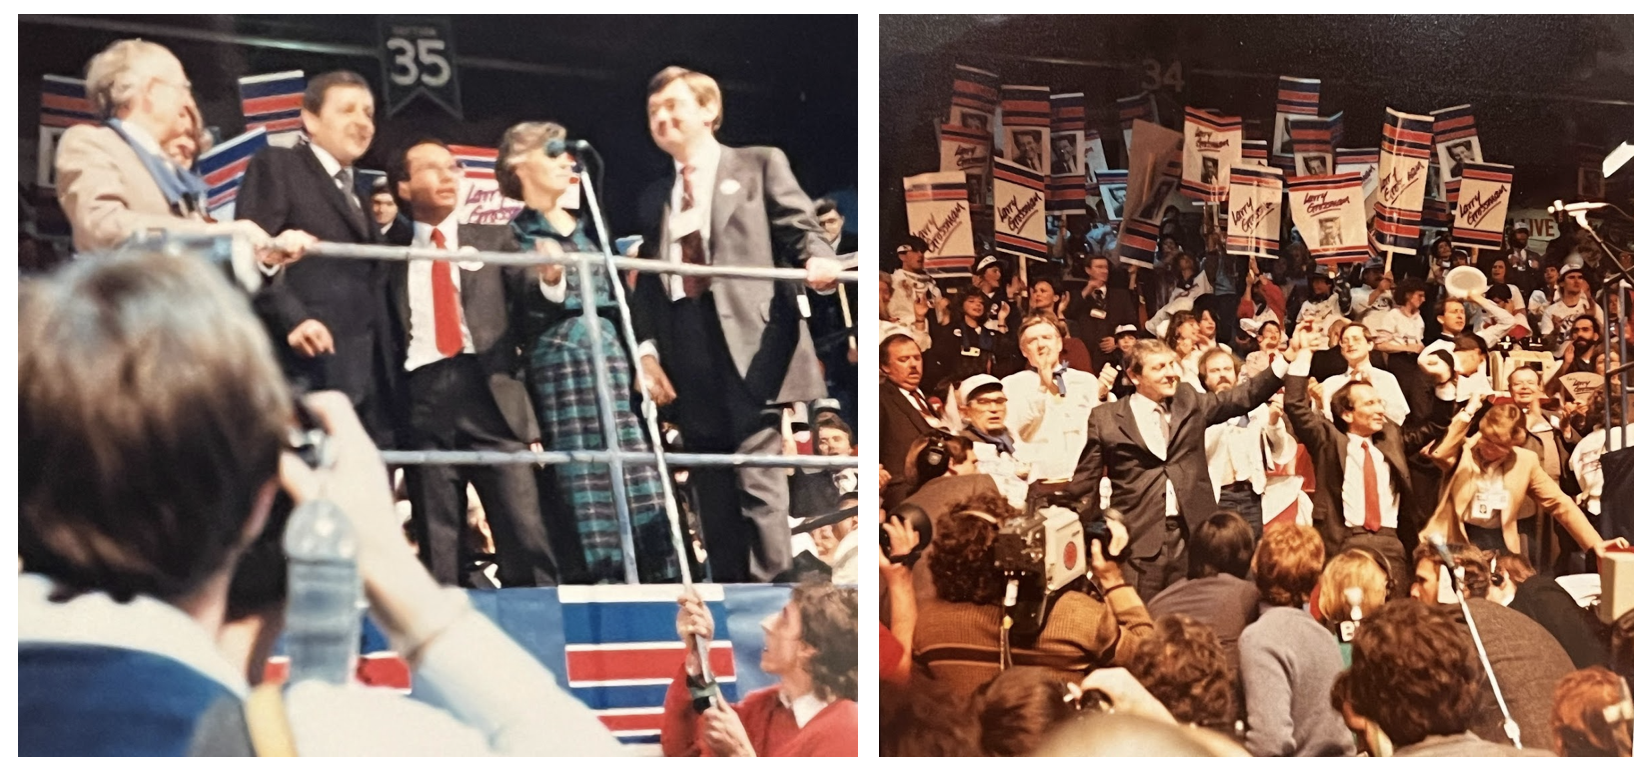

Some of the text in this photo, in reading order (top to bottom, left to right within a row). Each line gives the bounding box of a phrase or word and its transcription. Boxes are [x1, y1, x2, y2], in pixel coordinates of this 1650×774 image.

[387, 38, 451, 86] 35
[1141, 58, 1185, 92] 34
[997, 195, 1020, 223] Larry
[1008, 192, 1042, 231] Grossman
[1231, 197, 1254, 226] Larry
[1304, 191, 1328, 205] Larry
[1459, 190, 1481, 218] Larry
[1467, 184, 1507, 225] Grossman
[1521, 218, 1555, 237] IVE
